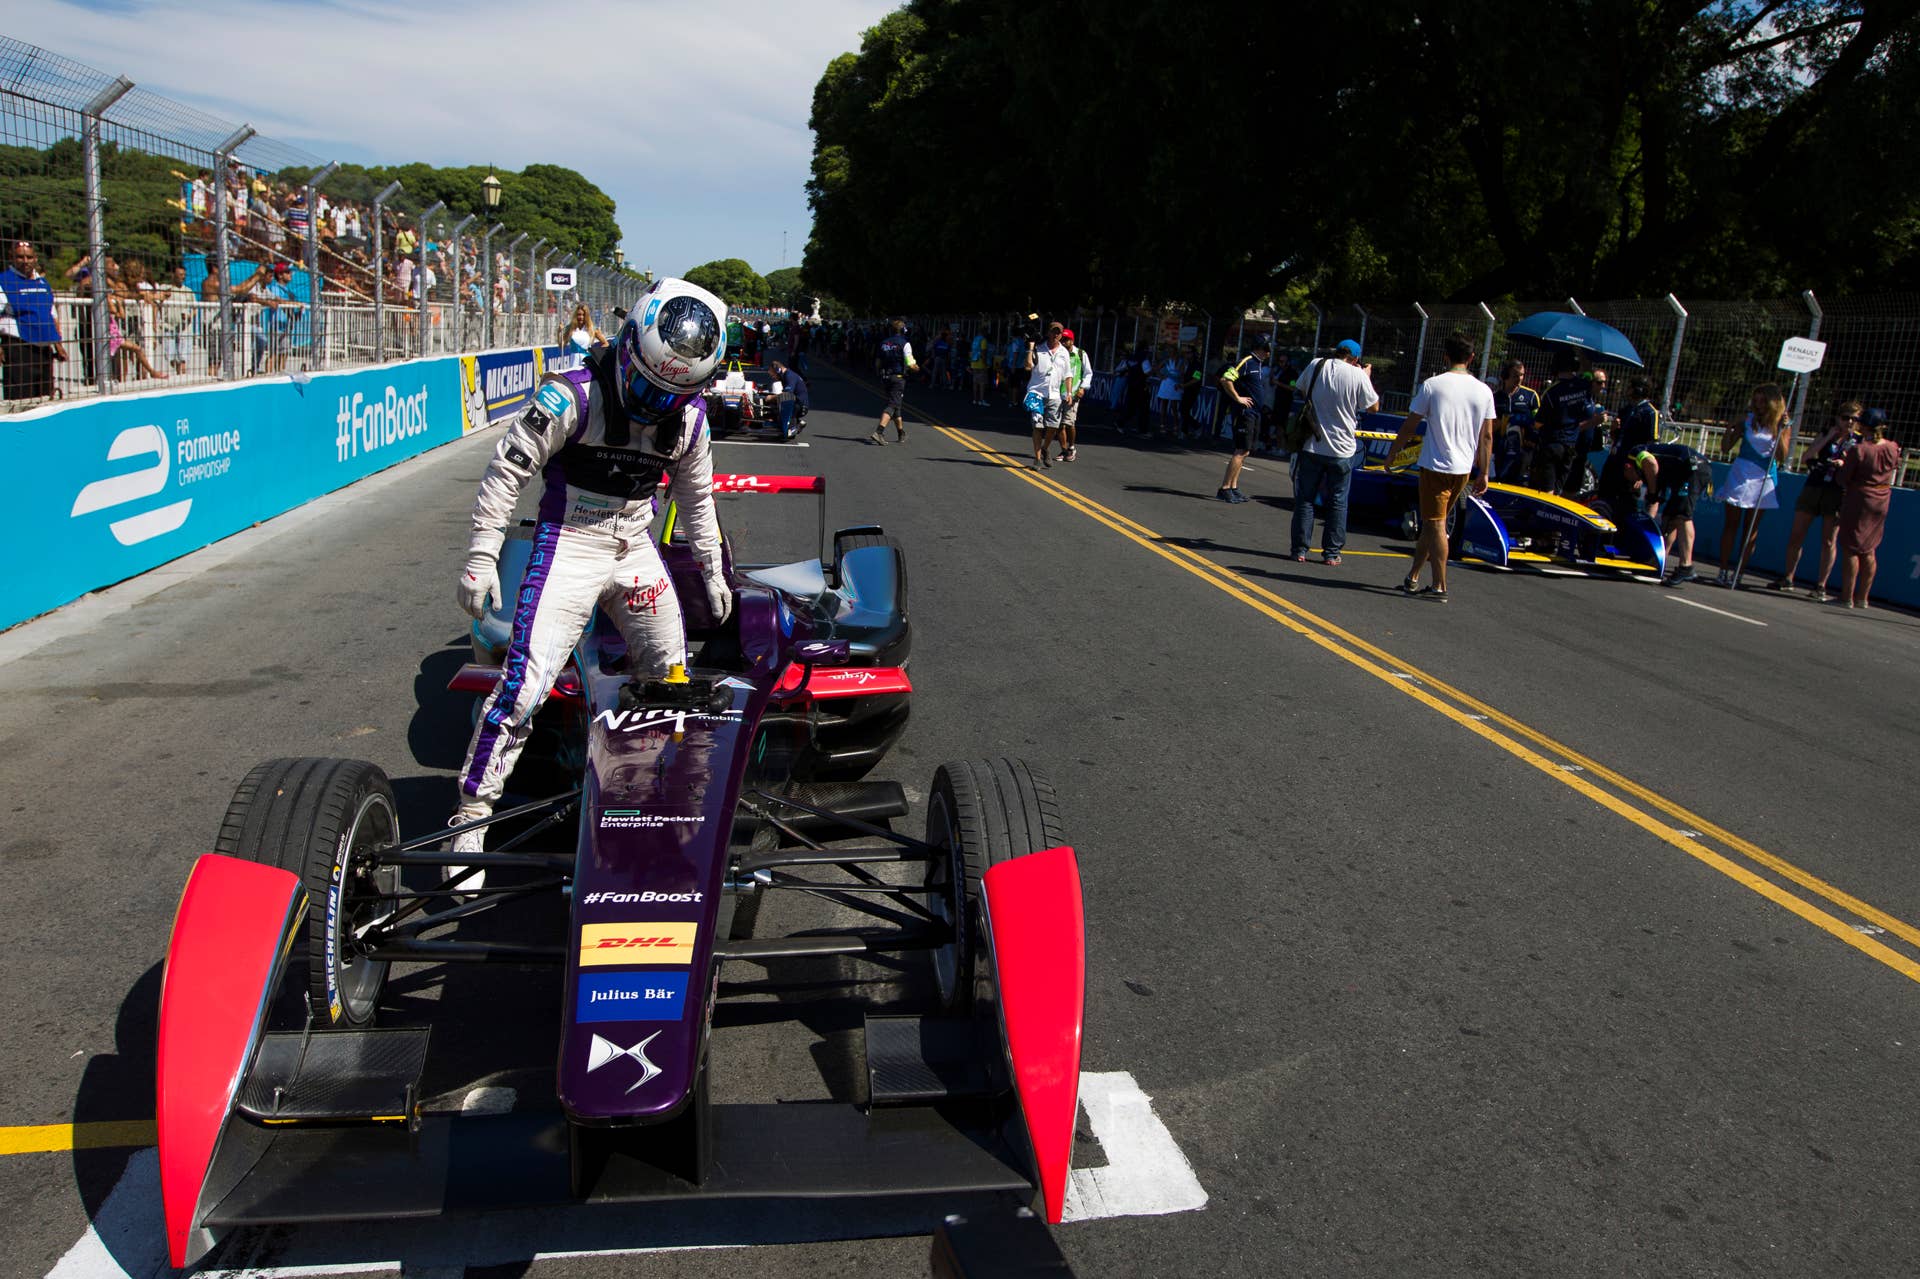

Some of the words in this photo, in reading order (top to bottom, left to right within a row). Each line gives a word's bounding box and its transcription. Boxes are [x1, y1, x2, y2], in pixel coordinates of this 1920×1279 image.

[659, 357, 689, 380] Virgin
[486, 361, 533, 401] MICHELIN
[176, 418, 189, 436] FIA
[336, 384, 427, 463] #FanBoost
[596, 451, 608, 459] DS
[178, 457, 231, 487] CHAMPIONSHIP
[574, 504, 615, 519] Hewlett
[571, 514, 625, 532] Enterprise
[623, 576, 669, 615] Virgin
[592, 707, 744, 732] Virg
[600, 821, 664, 829] Enterprise
[583, 891, 703, 904] #FanBoost
[327, 889, 338, 992] MICHELIN
[597, 936, 679, 949] DHL
[590, 989, 639, 1003] Julius
[644, 988, 675, 999] Bär
